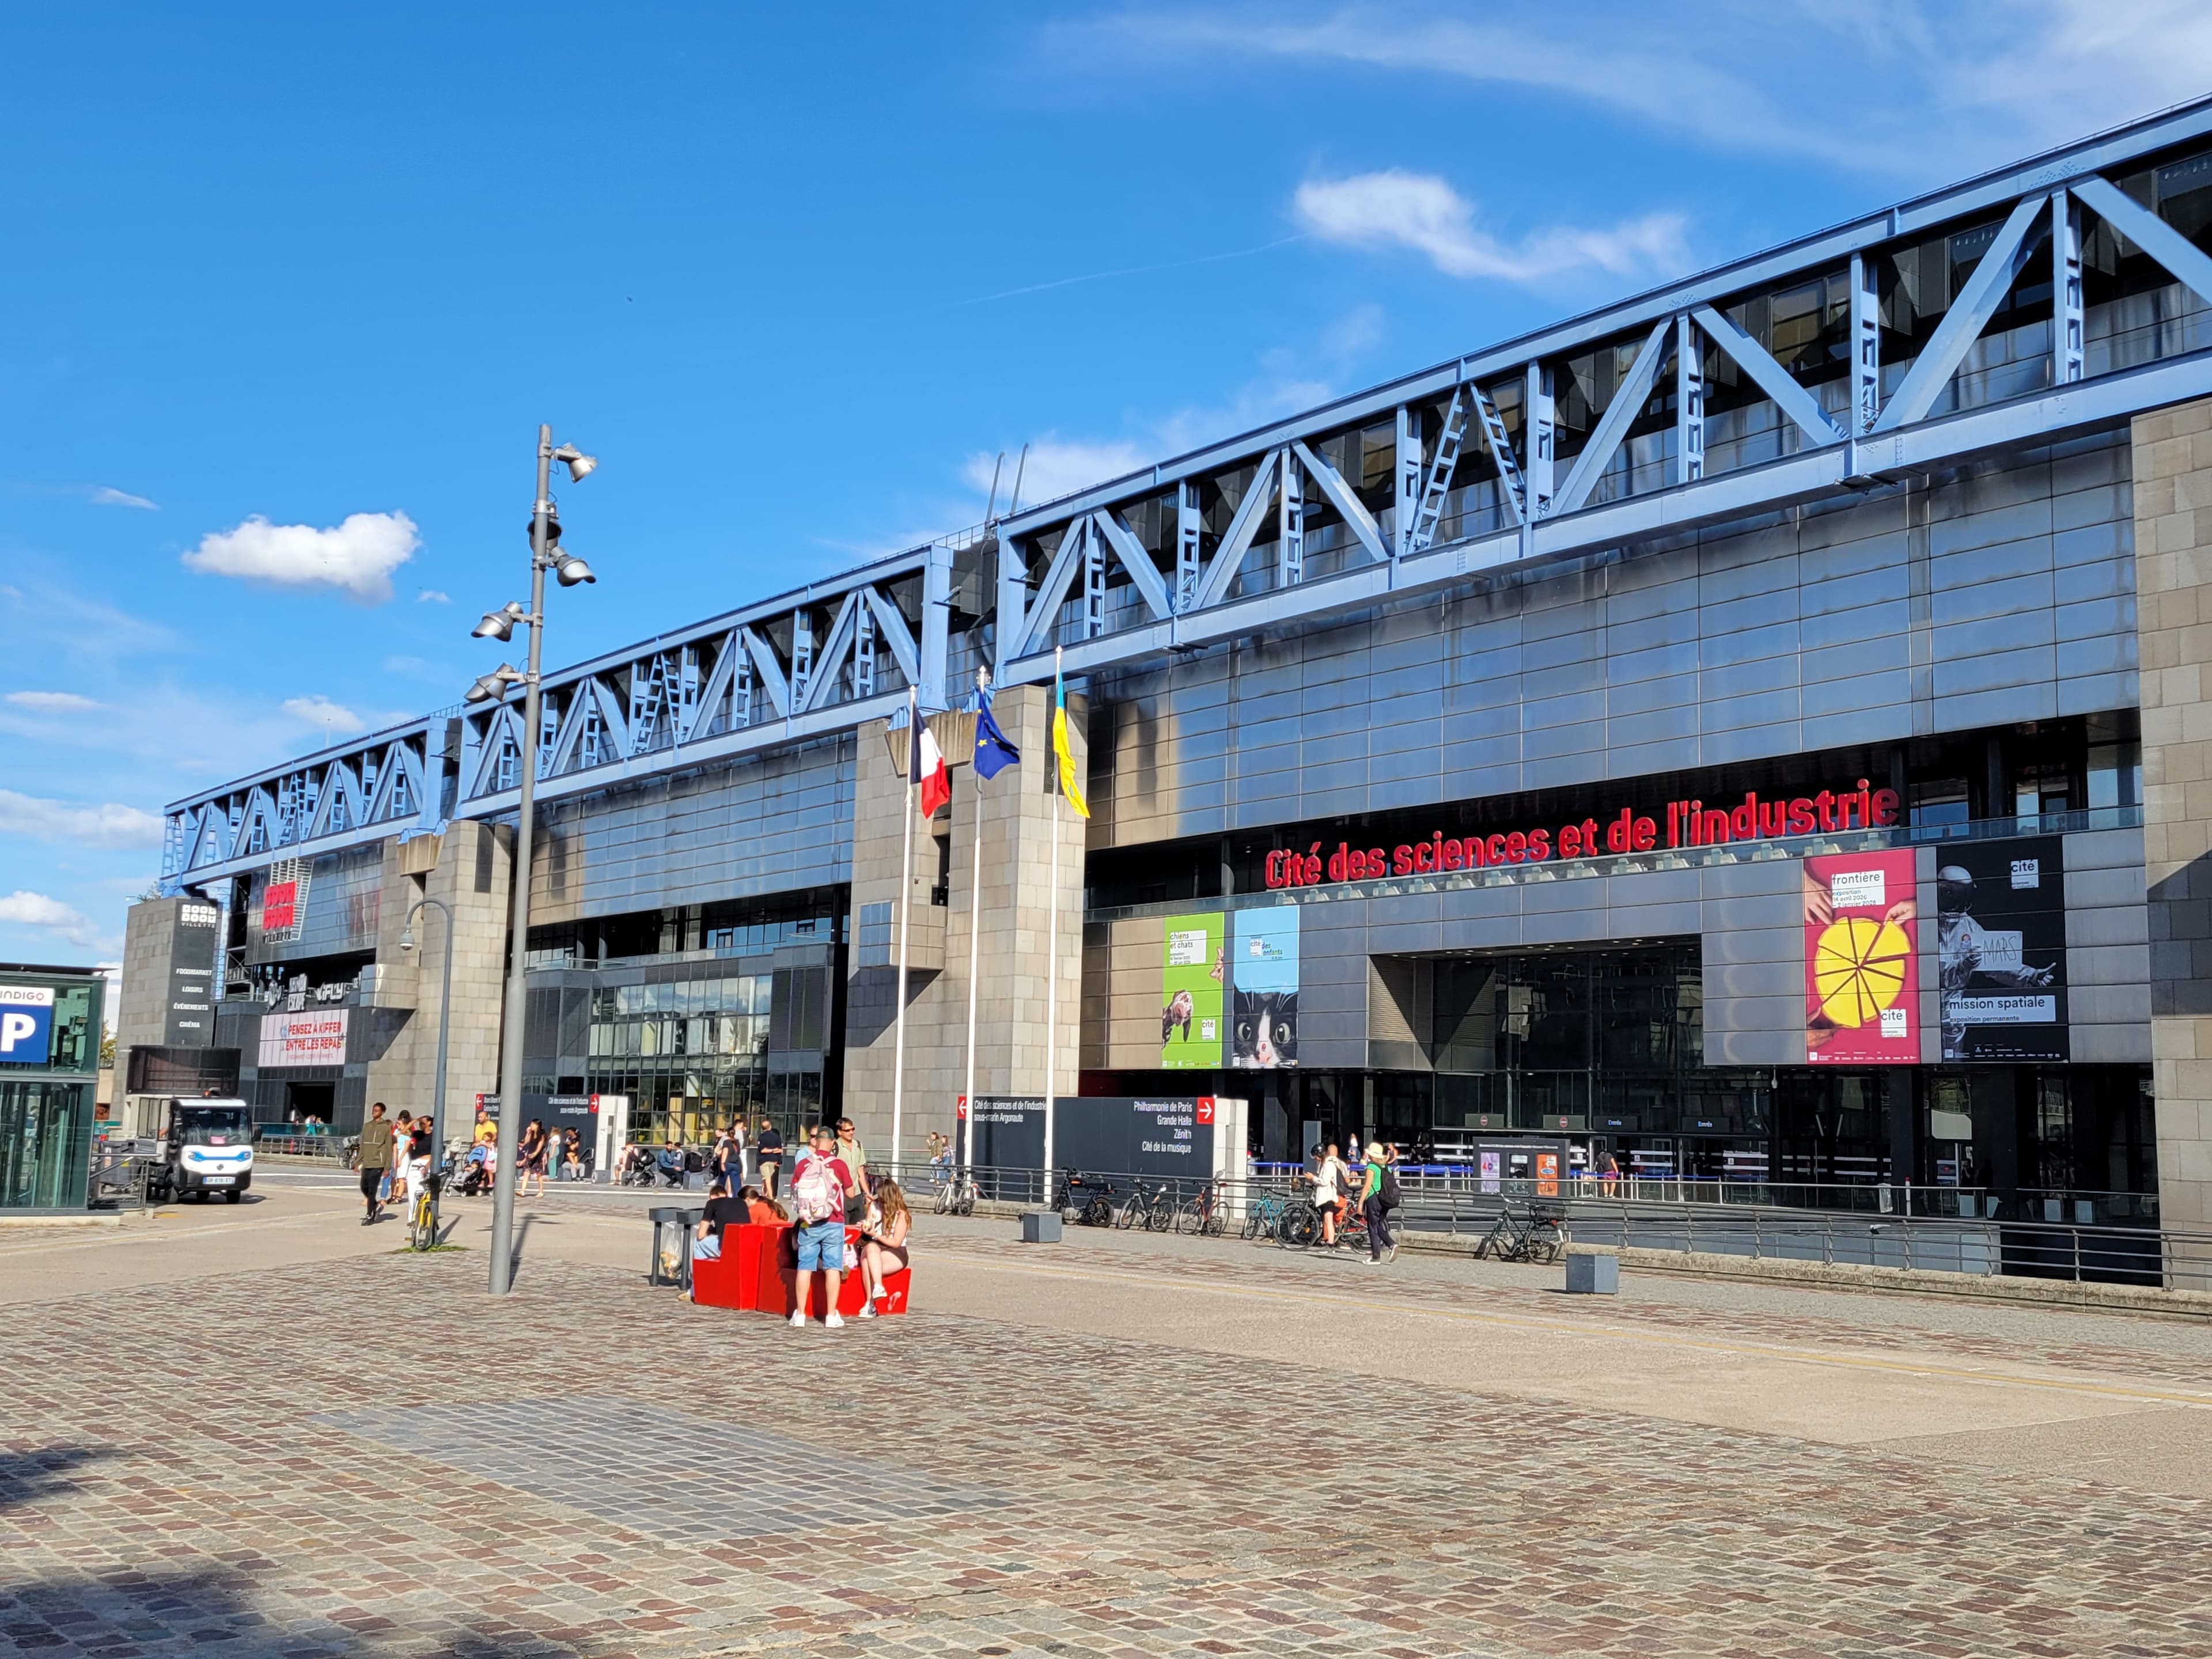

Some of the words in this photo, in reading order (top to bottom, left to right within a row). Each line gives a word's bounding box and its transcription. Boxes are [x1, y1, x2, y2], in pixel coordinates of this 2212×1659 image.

[1265, 842, 1321, 888] Cité
[1328, 842, 1385, 881] des
[1393, 831, 1550, 875] sciences
[1558, 819, 1597, 858] et
[1607, 808, 1656, 853] de
[1668, 778, 1900, 847] l'industrie
[2010, 859, 2035, 873] cité
[1832, 872, 1880, 885] frontière
[1171, 931, 1189, 940] chiens
[1983, 936, 2017, 965] MARS
[0, 990, 44, 1001] INDIGO
[1949, 998, 1994, 1010] mission
[1998, 995, 2046, 1010] spatiale
[1881, 1009, 1903, 1020] cité
[1950, 1016, 1981, 1024] exposition
[1982, 1015, 2020, 1023] permanente
[289, 1023, 312, 1035] PENSEZ
[319, 1021, 341, 1033] KIFFER
[1202, 1019, 1214, 1028] cité
[1, 1013, 36, 1052] P
[286, 1039, 306, 1051] ENTRE
[307, 1038, 319, 1050] LES
[321, 1037, 342, 1050] REPAS
[974, 1100, 983, 1109] Cité
[993, 1100, 1012, 1110] sciences
[1013, 1101, 1017, 1110] et
[1018, 1101, 1024, 1110] de
[1134, 1101, 1169, 1112] Philharmonie
[1169, 1101, 1177, 1112] de
[1178, 1102, 1192, 1112] Paris
[974, 1113, 999, 1122] sous-marin
[999, 1112, 1023, 1124] Argonaute
[1157, 1115, 1177, 1125] Grande
[1178, 1115, 1192, 1126] Halle
[1174, 1128, 1191, 1139] Zénith
[1142, 1141, 1153, 1152] Cité
[1153, 1141, 1160, 1152] de
[1161, 1141, 1166, 1152] la
[1167, 1143, 1191, 1155] musique
